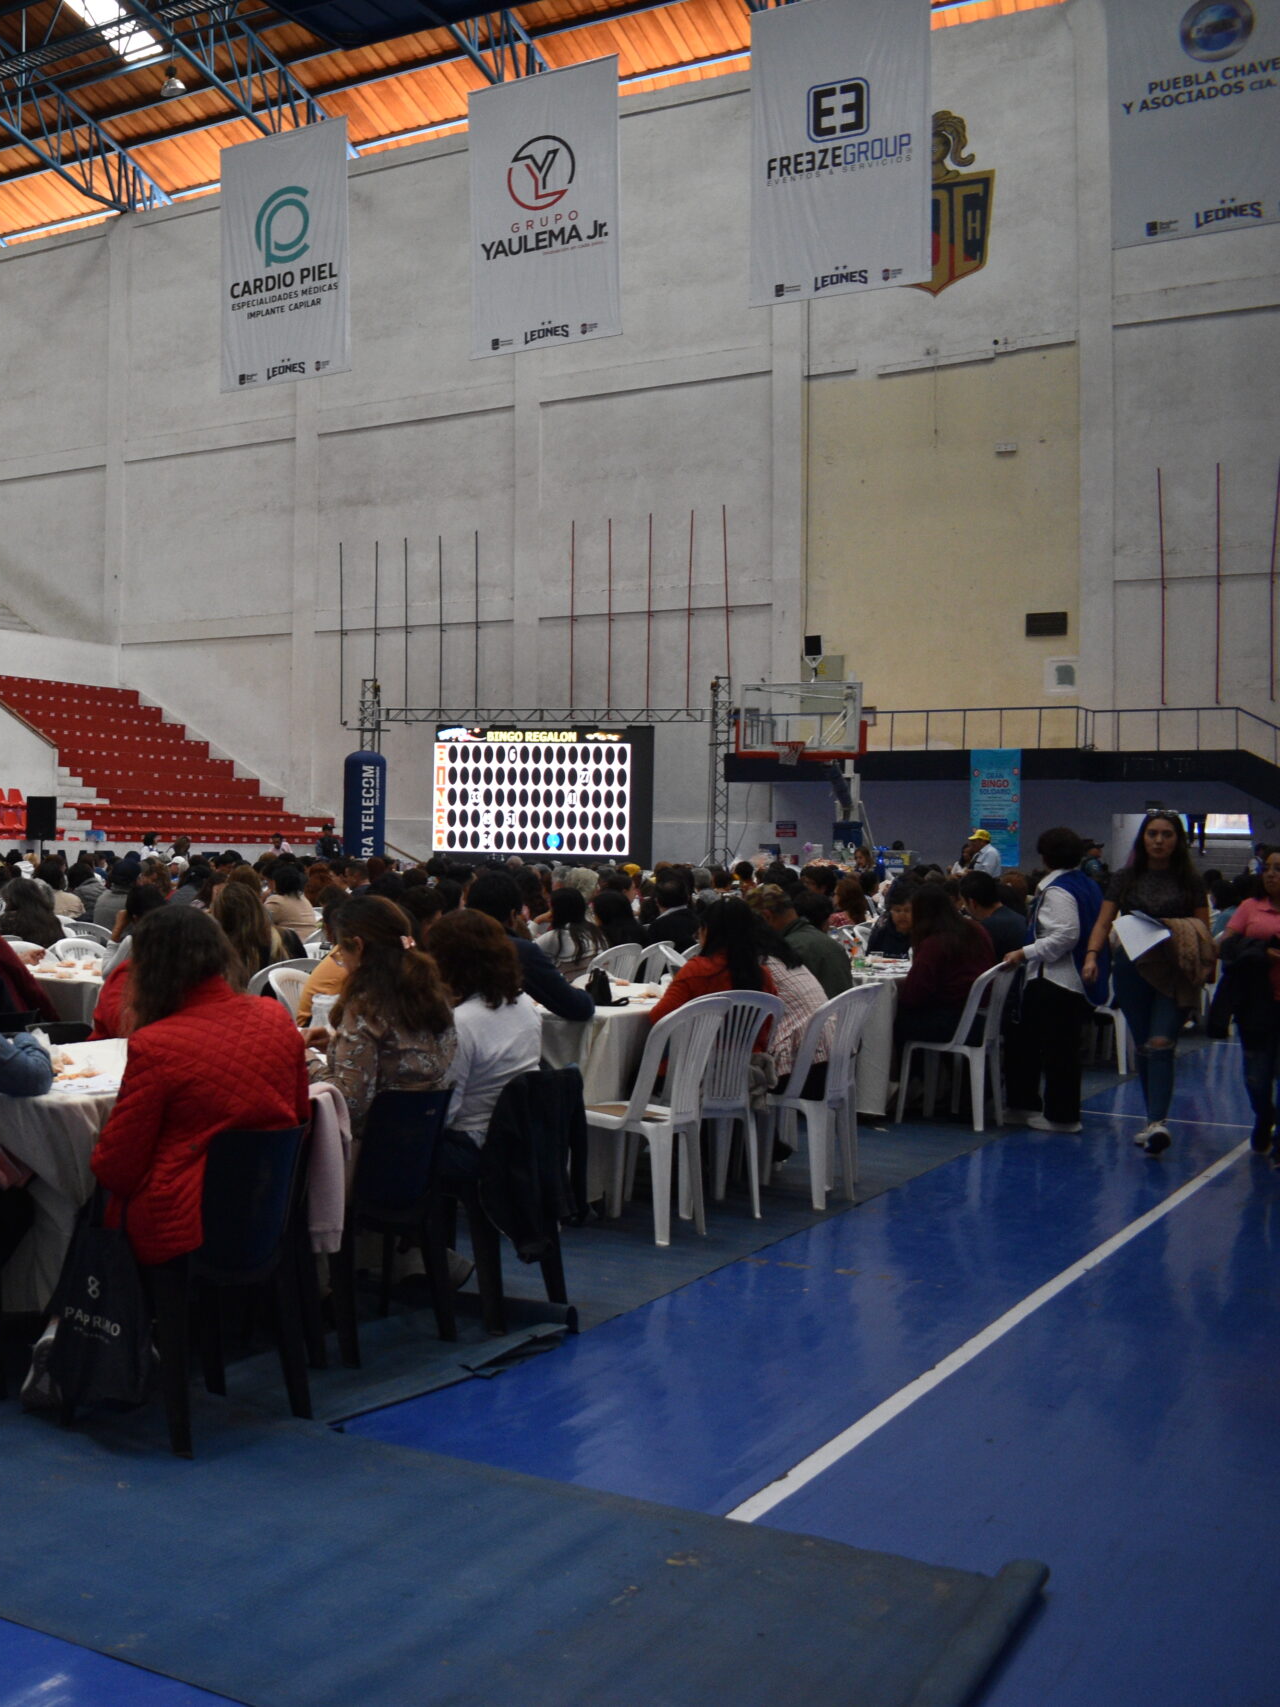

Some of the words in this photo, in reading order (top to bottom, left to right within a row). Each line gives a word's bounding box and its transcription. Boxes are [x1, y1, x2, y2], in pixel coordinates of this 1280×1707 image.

[1148, 70, 1217, 95] PUEBLA
[1122, 102, 1134, 115] Y
[1138, 80, 1245, 113] ASOCIADOS
[1249, 79, 1277, 92] CIA.
[766, 171, 821, 187] EVENTOS
[842, 154, 912, 173] SERVICIOS
[510, 210, 579, 234] GRUPO
[1194, 201, 1263, 229] LEONES
[481, 224, 583, 261] YAULEMA
[586, 219, 609, 240] Jr.
[230, 270, 295, 300] CARDIO
[300, 262, 338, 285] PIEL
[814, 269, 869, 293] LEONES
[231, 290, 299, 312] ESPECIALIDADES
[246, 305, 286, 320] IMPLANTE
[288, 297, 322, 312] CAPILAR
[524, 323, 570, 345] LEONES
[267, 361, 306, 381] LEONES
[486, 731, 524, 742] BINGO
[525, 731, 578, 743] REGALON
[981, 779, 1009, 788] BINGO
[361, 765, 375, 832] TELECOM
